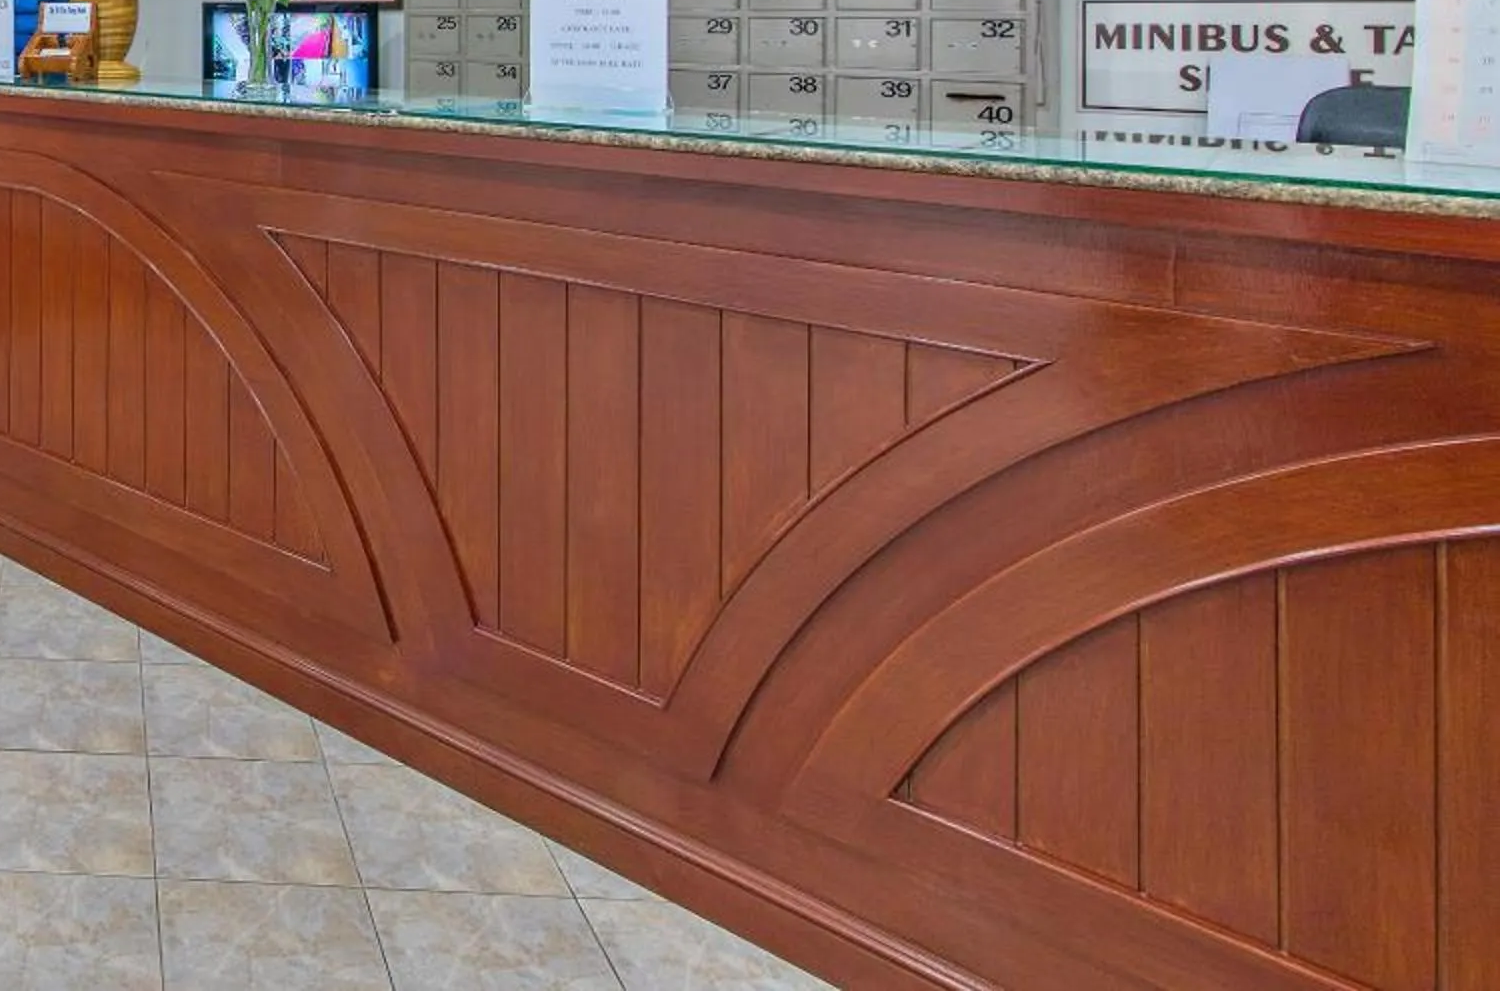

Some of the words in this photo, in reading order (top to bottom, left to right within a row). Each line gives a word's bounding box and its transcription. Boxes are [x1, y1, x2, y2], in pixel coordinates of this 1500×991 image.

[437, 18, 456, 30] 25
[497, 18, 516, 31] 26
[708, 19, 732, 34] 29
[790, 19, 818, 35] 30
[886, 20, 910, 36] 31
[982, 21, 1015, 37] 32
[1095, 23, 1290, 53] MINIBUS
[1309, 24, 1346, 55] &
[437, 65, 455, 77] 33
[497, 66, 516, 78] 34
[708, 76, 732, 89] 37
[790, 77, 816, 93] 38
[881, 81, 912, 98] 39
[978, 106, 1013, 123] 40
